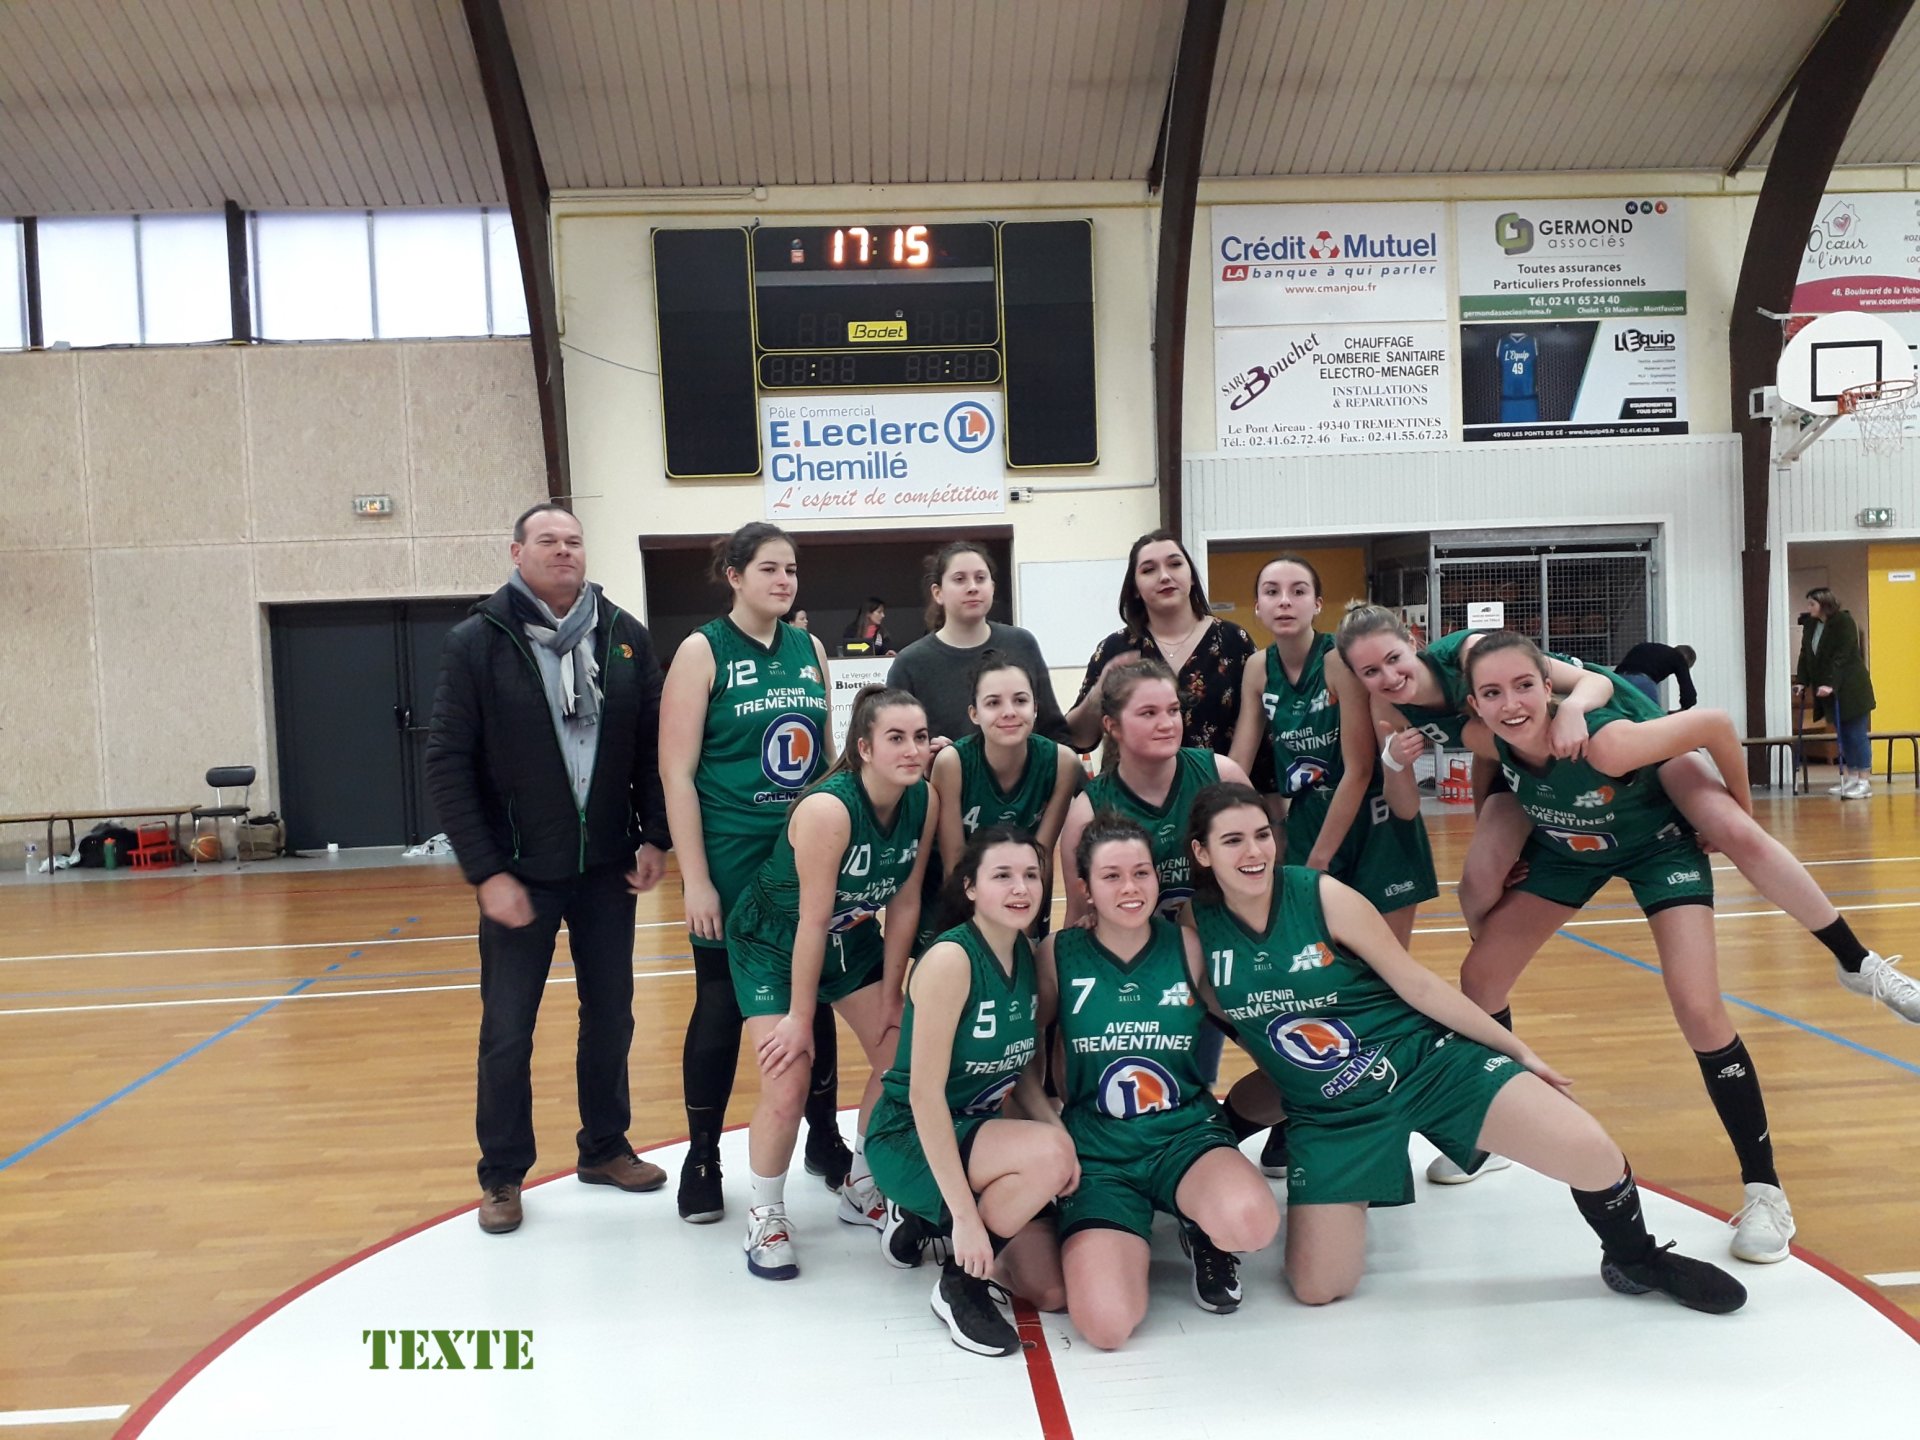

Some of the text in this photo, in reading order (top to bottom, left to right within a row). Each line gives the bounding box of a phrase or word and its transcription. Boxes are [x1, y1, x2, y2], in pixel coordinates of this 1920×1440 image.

[1539, 219, 1633, 236] GERMOND
[1221, 233, 1437, 261] Crédit Mutuel
[1548, 235, 1625, 249] associés
[1226, 264, 1436, 280] LA banque à qui parler
[1518, 262, 1622, 274] Toutes assurances
[1285, 283, 1377, 295] www.cmanjou.fr
[1493, 276, 1646, 290] Particuliers Professionnels
[1845, 286, 1882, 296] Boulevard
[1529, 294, 1620, 307] Tél. 02 41 65 24 40
[1577, 305, 1599, 314] Cholet
[852, 323, 904, 339] Bodet
[1344, 336, 1414, 349] CHAUFFAGE
[1313, 350, 1446, 365] PLOMBERIE SANITAIRE
[1230, 332, 1321, 411] Bouchet
[1320, 365, 1439, 379] ELECTRO-MENAGER
[1512, 362, 1524, 375] 49
[1333, 384, 1428, 396] INSTALLATIONS
[1333, 396, 1428, 408] & REPARATIONS
[769, 404, 875, 419] Pôle Commercial
[770, 418, 940, 448] E.Leclerc
[1228, 424, 1242, 434] Le
[1245, 423, 1268, 433] Pont
[1271, 422, 1306, 433] Aireau
[1317, 420, 1350, 431] 49340
[1353, 417, 1441, 430] TREMENTINES
[1249, 434, 1331, 446] 02.41.62.72.46
[771, 451, 908, 482] Chemillé
[774, 486, 999, 511] L'esprit de compétition
[727, 660, 758, 688] 12
[767, 687, 806, 697] AVENIR
[1531, 804, 1576, 819] AVENIR
[963, 805, 981, 834] 4
[841, 843, 871, 876] 10
[1212, 949, 1234, 987] 11
[1071, 978, 1096, 1015] 7
[1247, 988, 1295, 1004] AVENIR
[972, 1000, 996, 1038] 5
[1105, 1021, 1160, 1034] AVENIR
[1004, 1037, 1034, 1057] AVENIR
[1071, 1034, 1193, 1054] TREMENTINES
